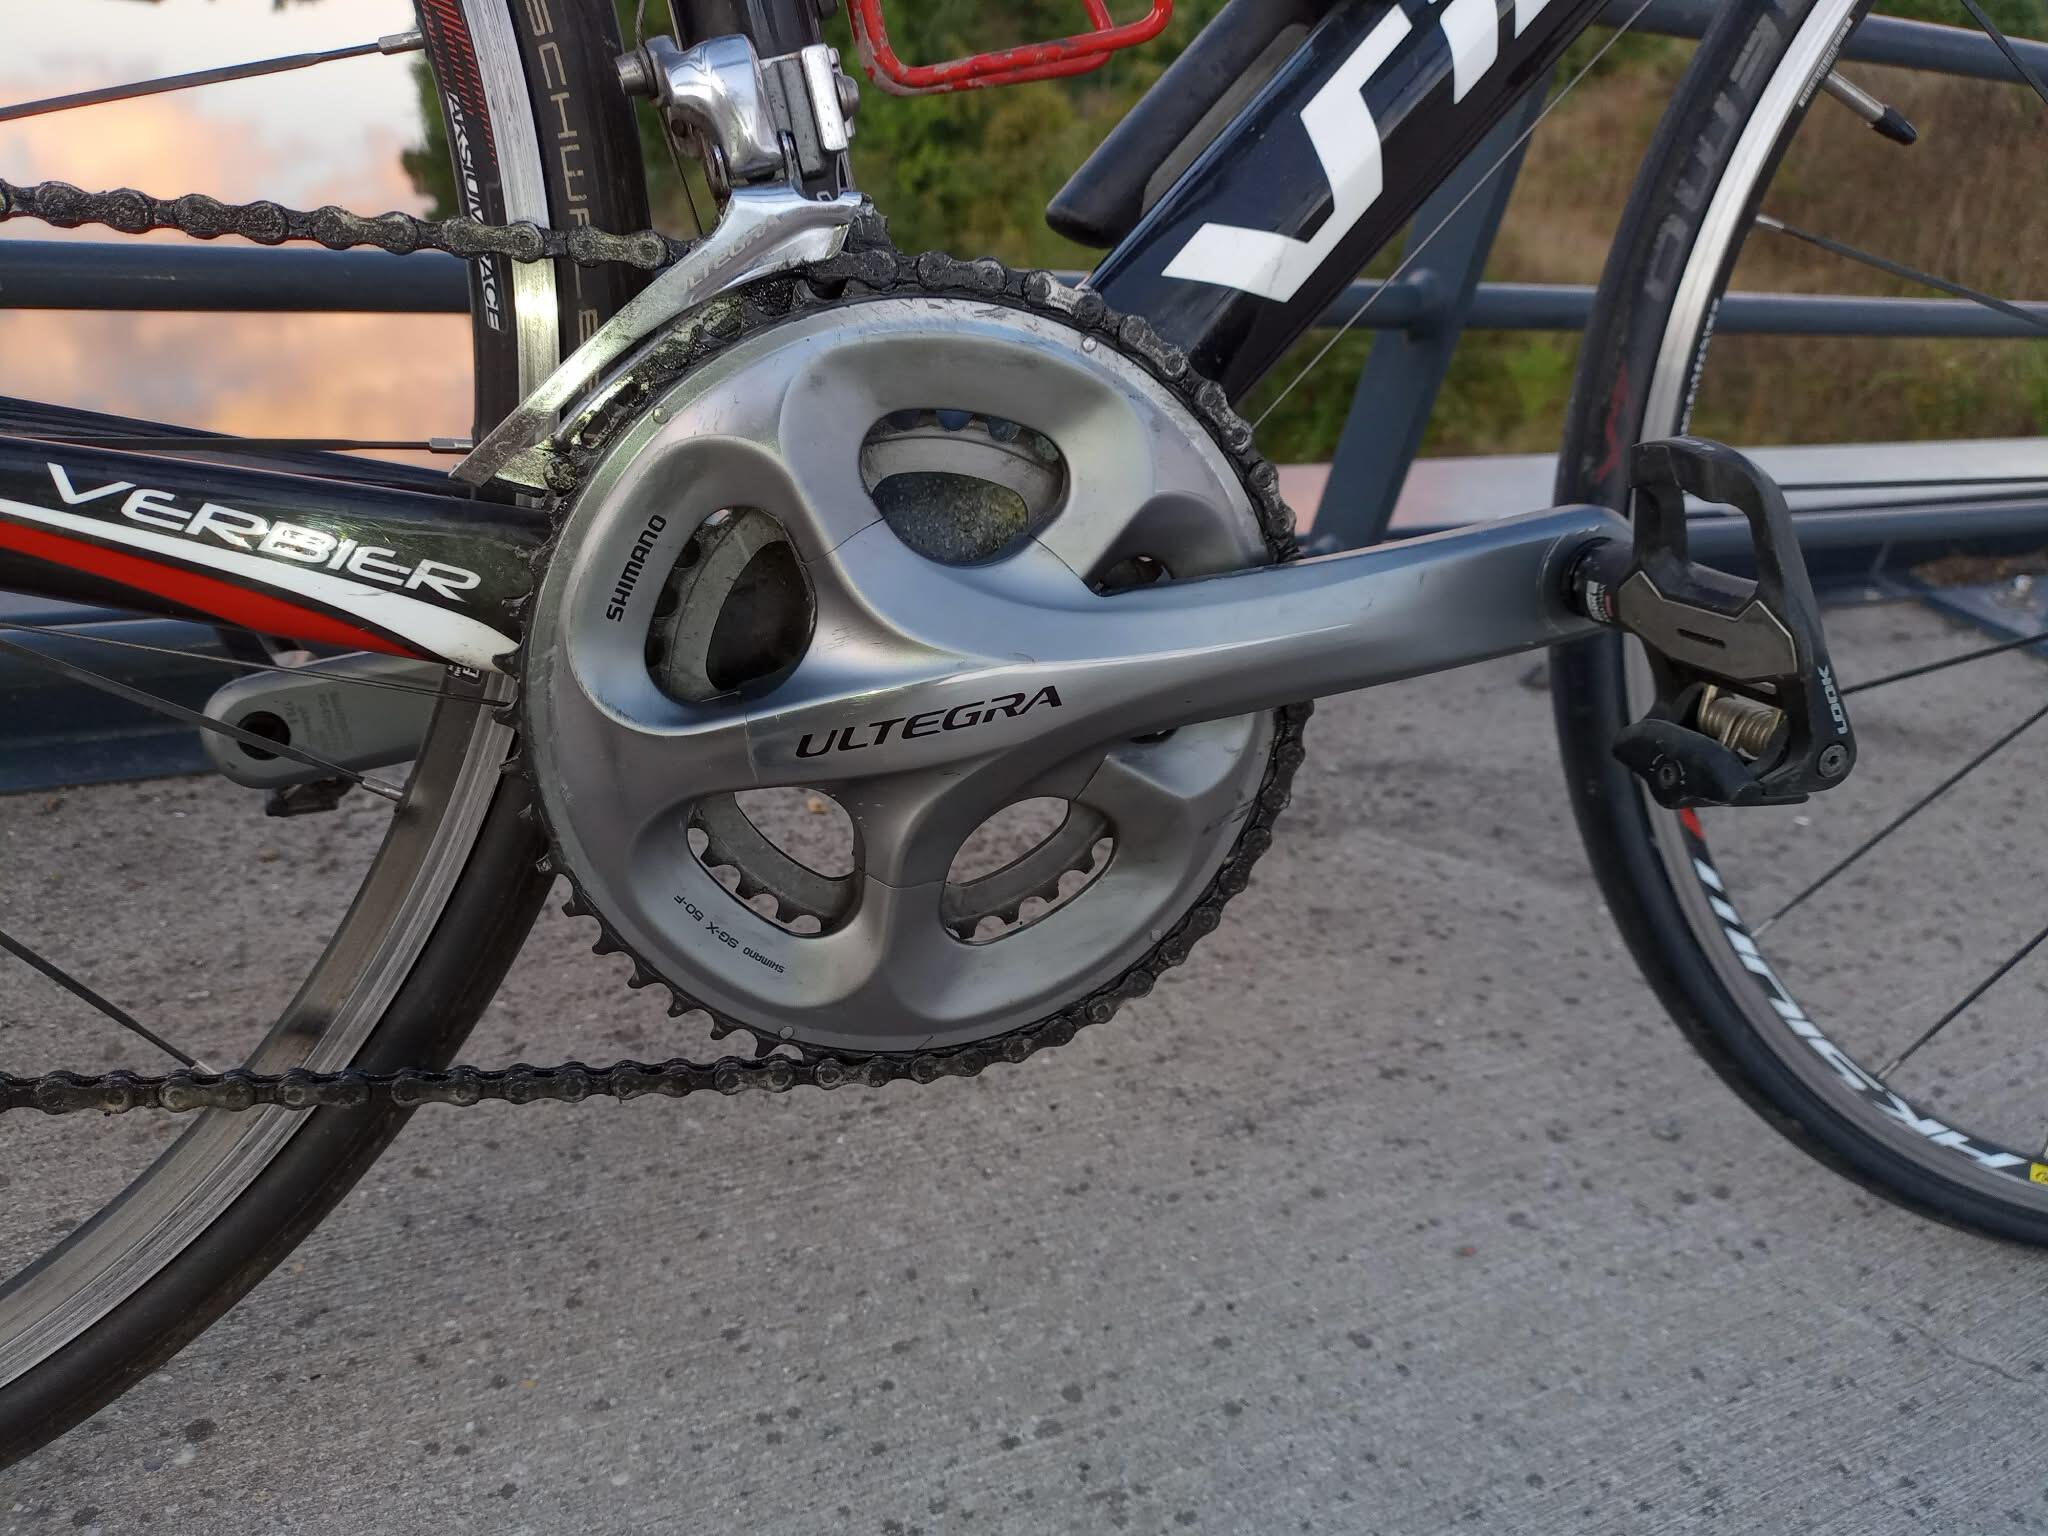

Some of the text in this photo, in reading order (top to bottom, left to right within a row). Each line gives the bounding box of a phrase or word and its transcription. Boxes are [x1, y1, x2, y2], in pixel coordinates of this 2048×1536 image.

[478, 252, 500, 331] ACE
[46, 461, 482, 602] VERBIER
[605, 513, 668, 623] SHIMANO
[794, 684, 1063, 759] ULTEGRA
[1817, 664, 1849, 735] LOOK
[673, 892, 786, 974] SHIMANO SG-X 50-F
